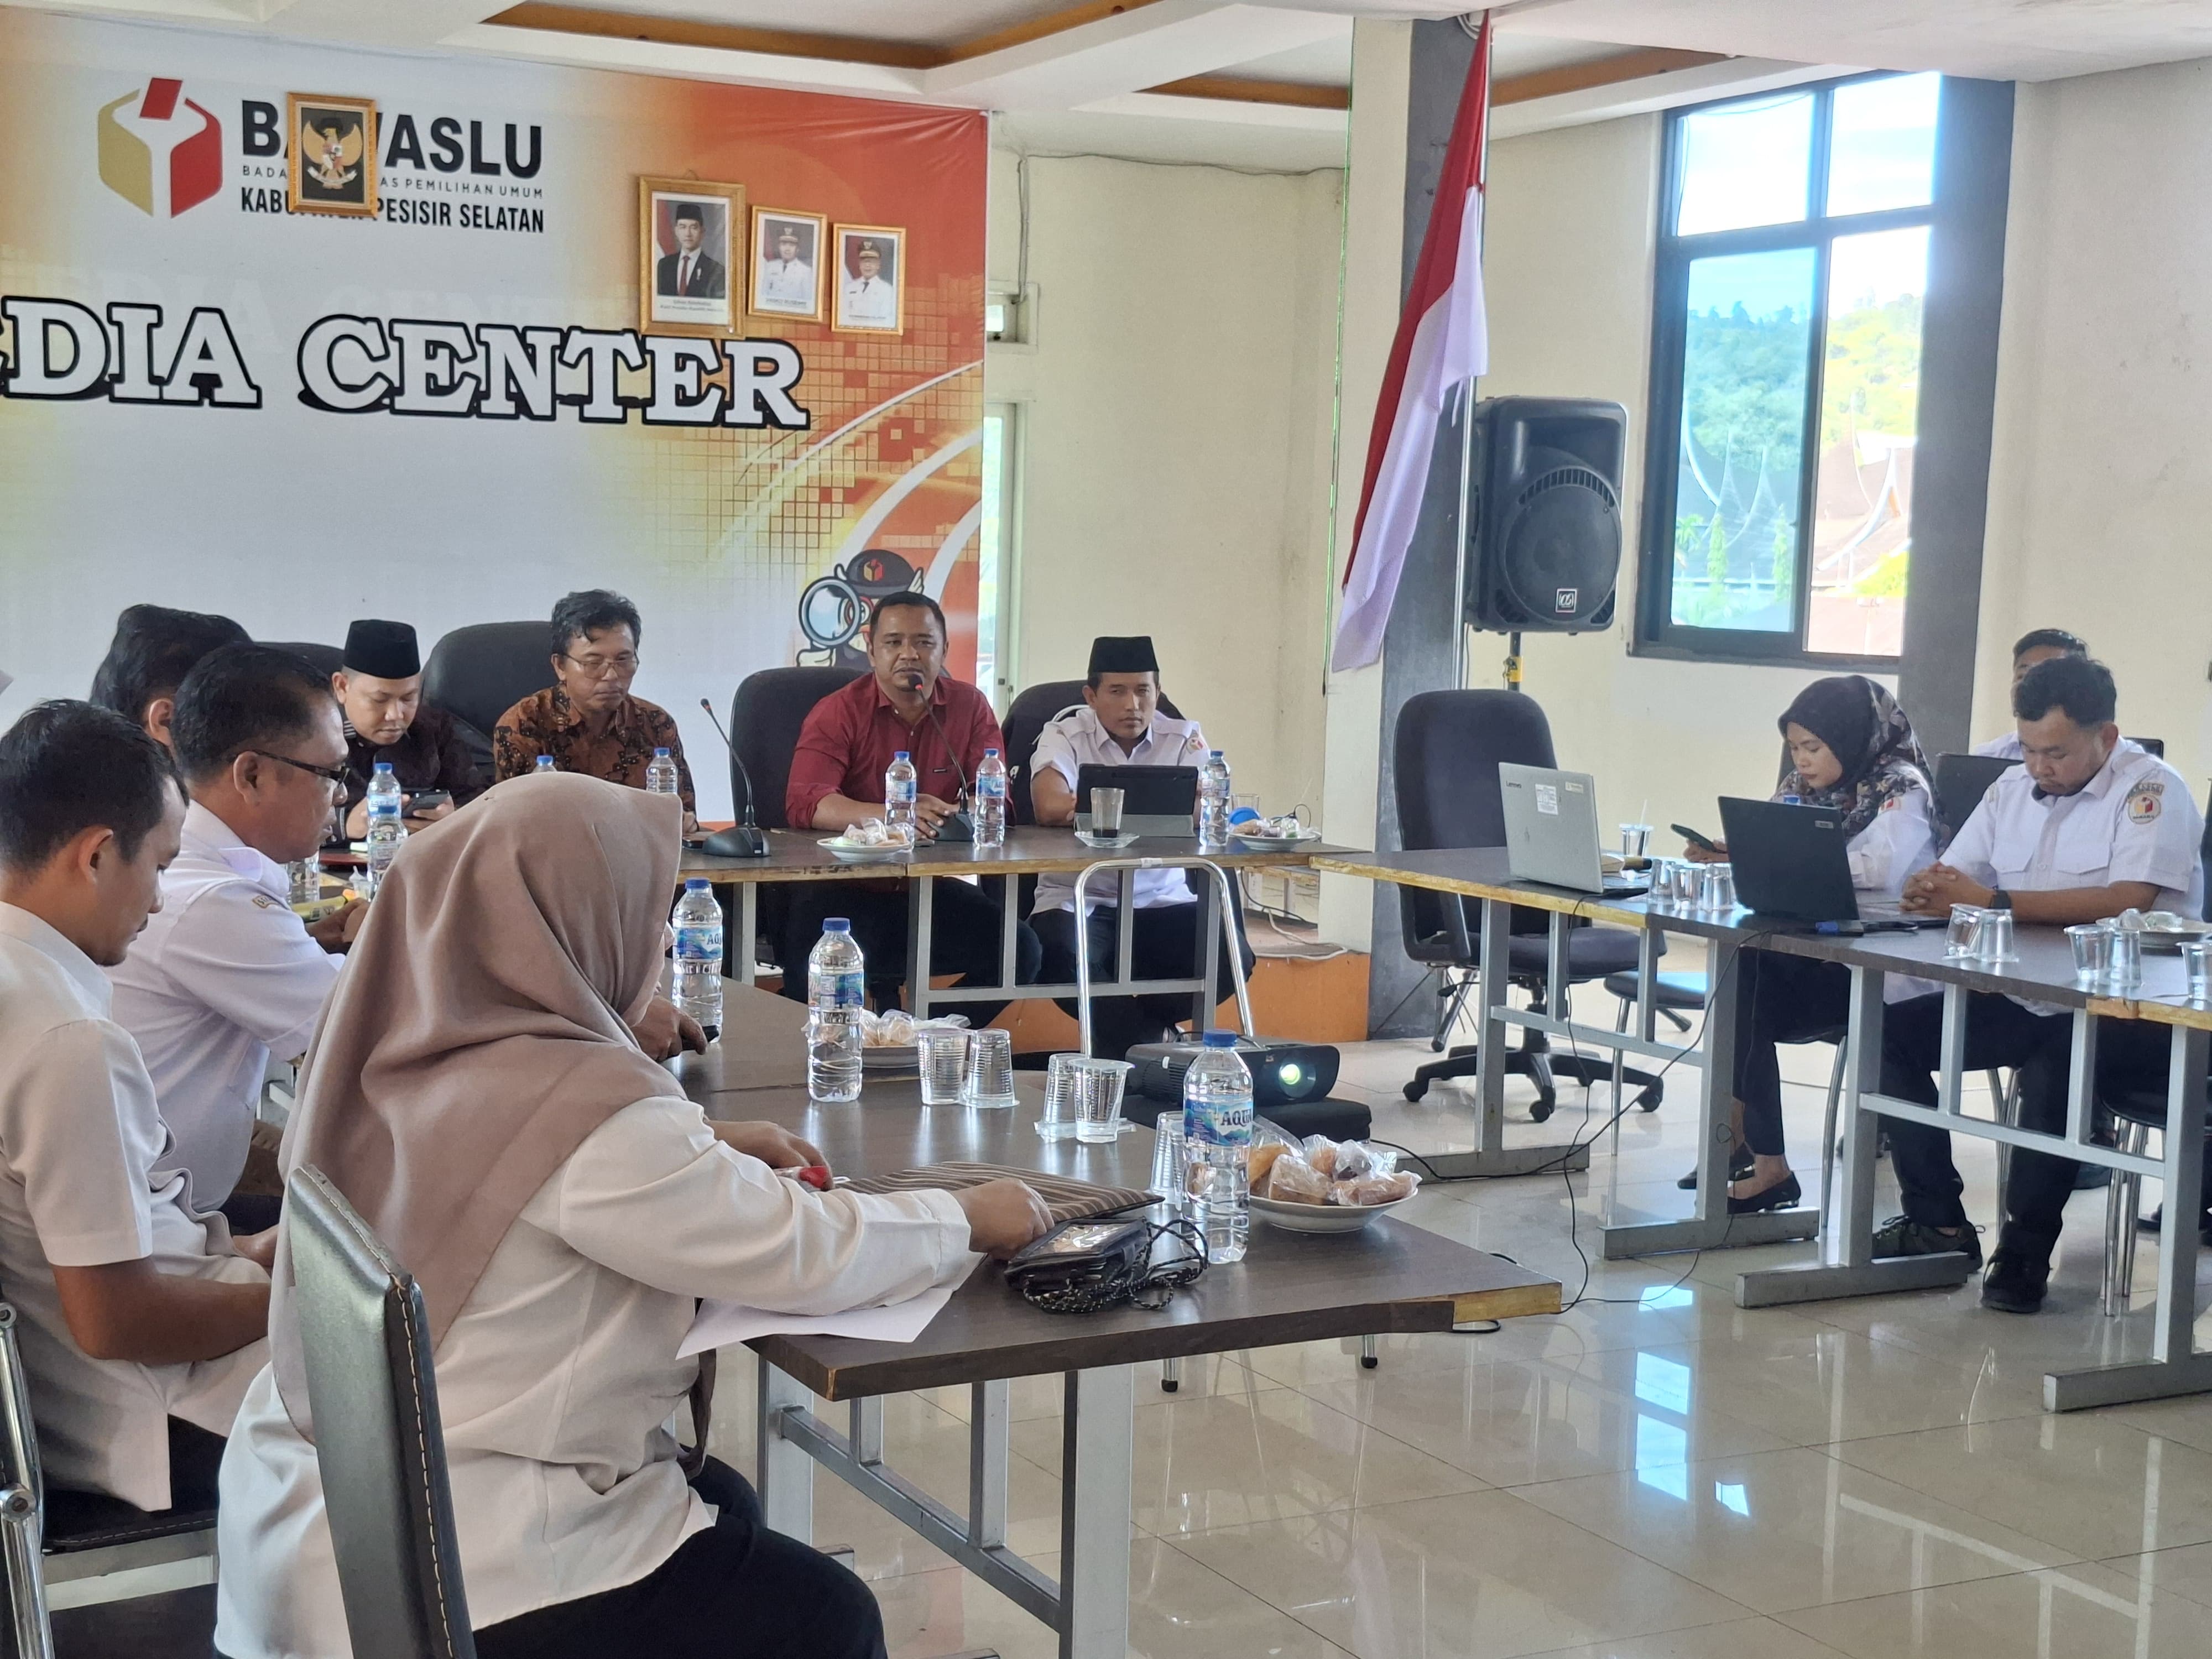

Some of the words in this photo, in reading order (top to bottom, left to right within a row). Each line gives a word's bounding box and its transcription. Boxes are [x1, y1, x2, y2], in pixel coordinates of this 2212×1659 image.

[242, 100, 542, 179] BASLU
[243, 165, 288, 179] BADA
[405, 178, 493, 196] PEMILIHAN
[499, 185, 542, 199] UMUM
[460, 203, 544, 234] SELATAN
[0, 295, 263, 409] DIA
[297, 314, 811, 430] CENTER
